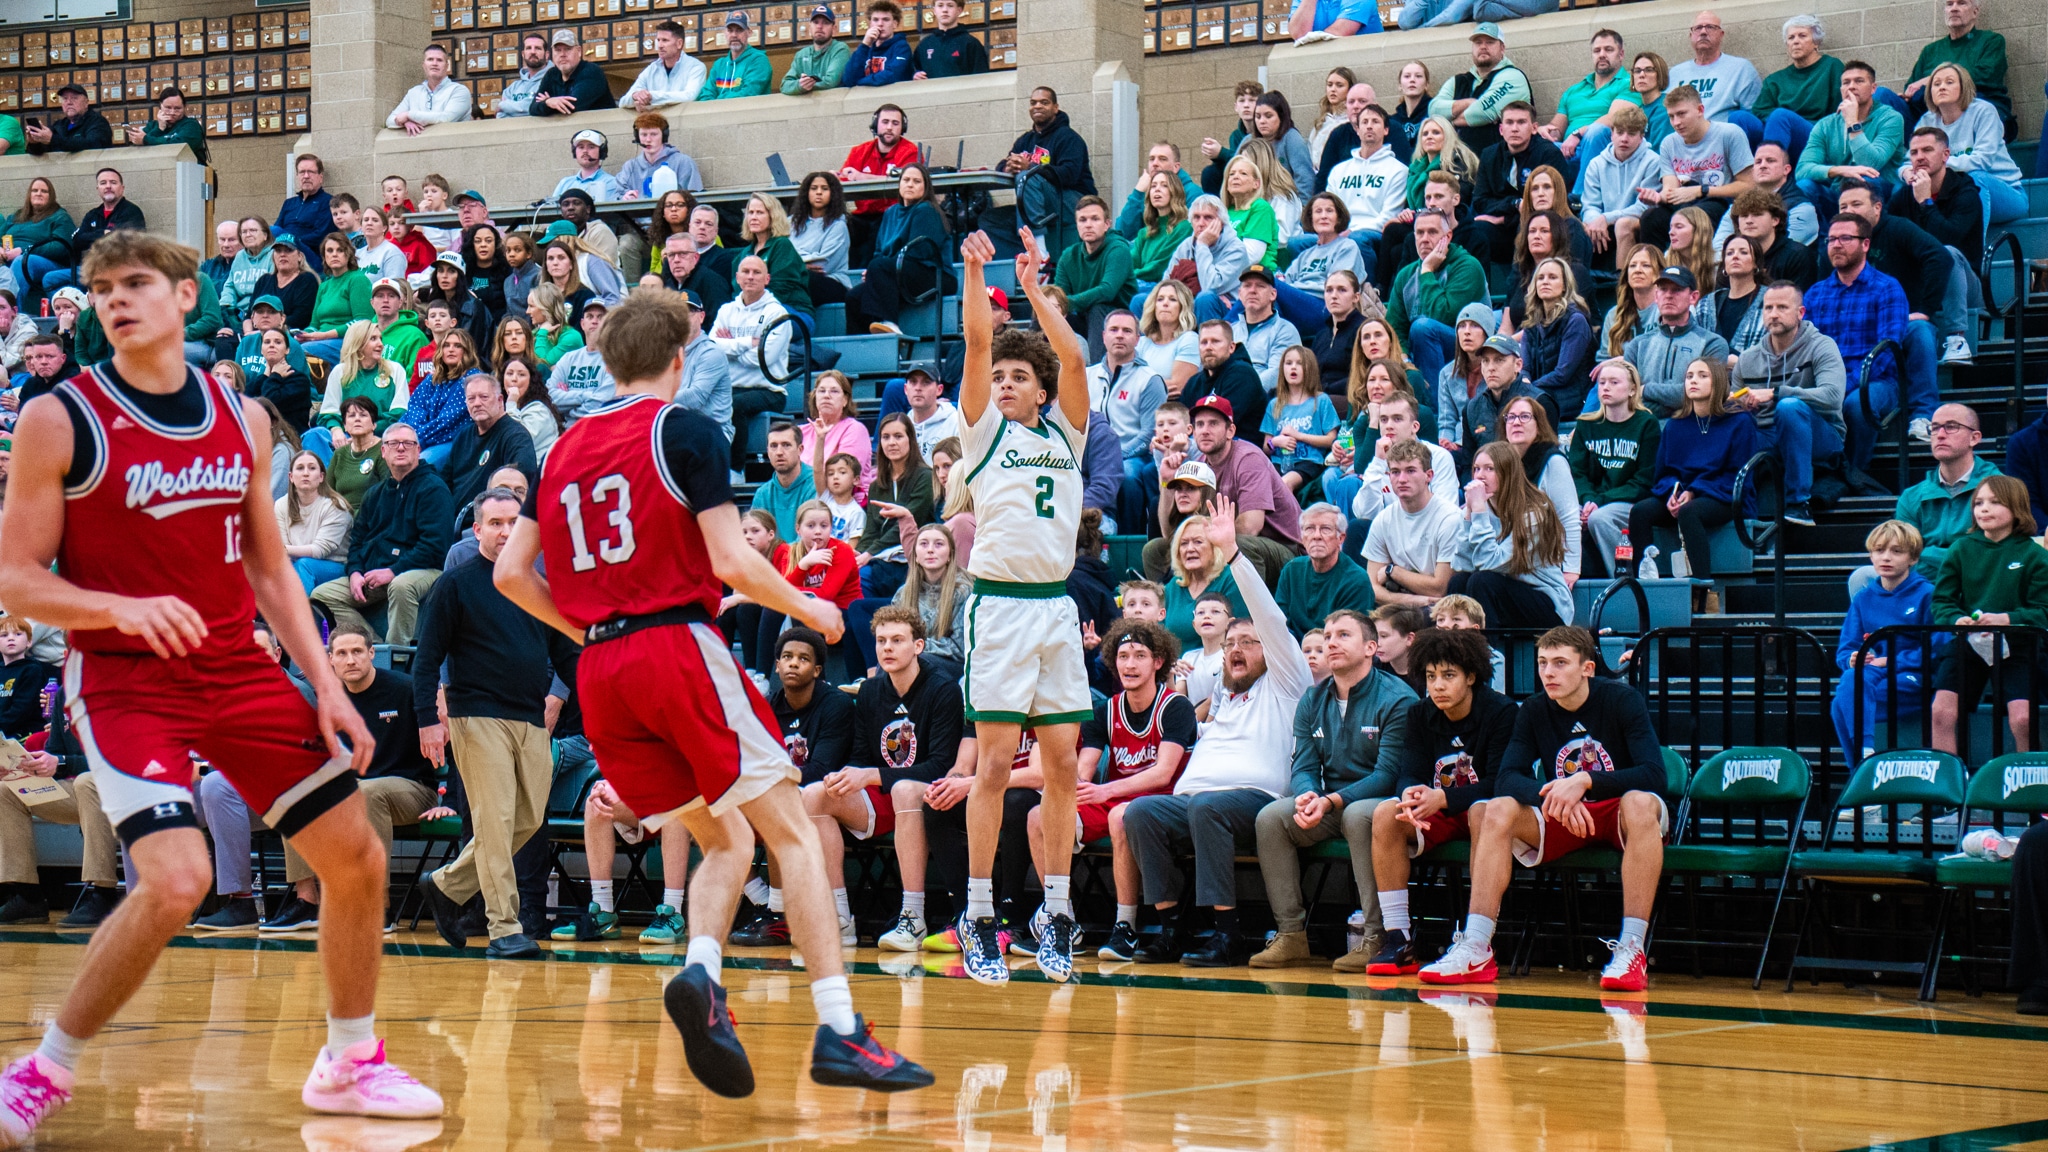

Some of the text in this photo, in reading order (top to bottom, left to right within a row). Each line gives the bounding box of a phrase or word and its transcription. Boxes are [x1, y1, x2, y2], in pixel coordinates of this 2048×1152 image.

[568, 365, 602, 381] LSW
[1118, 390, 1129, 400] N
[1204, 395, 1218, 406] P
[125, 453, 250, 509] Westside
[1035, 475, 1055, 519] 2
[560, 473, 637, 573] 13
[1722, 759, 1782, 791] SOUTHWEST
[1873, 760, 1940, 791] SOUTHWEST
